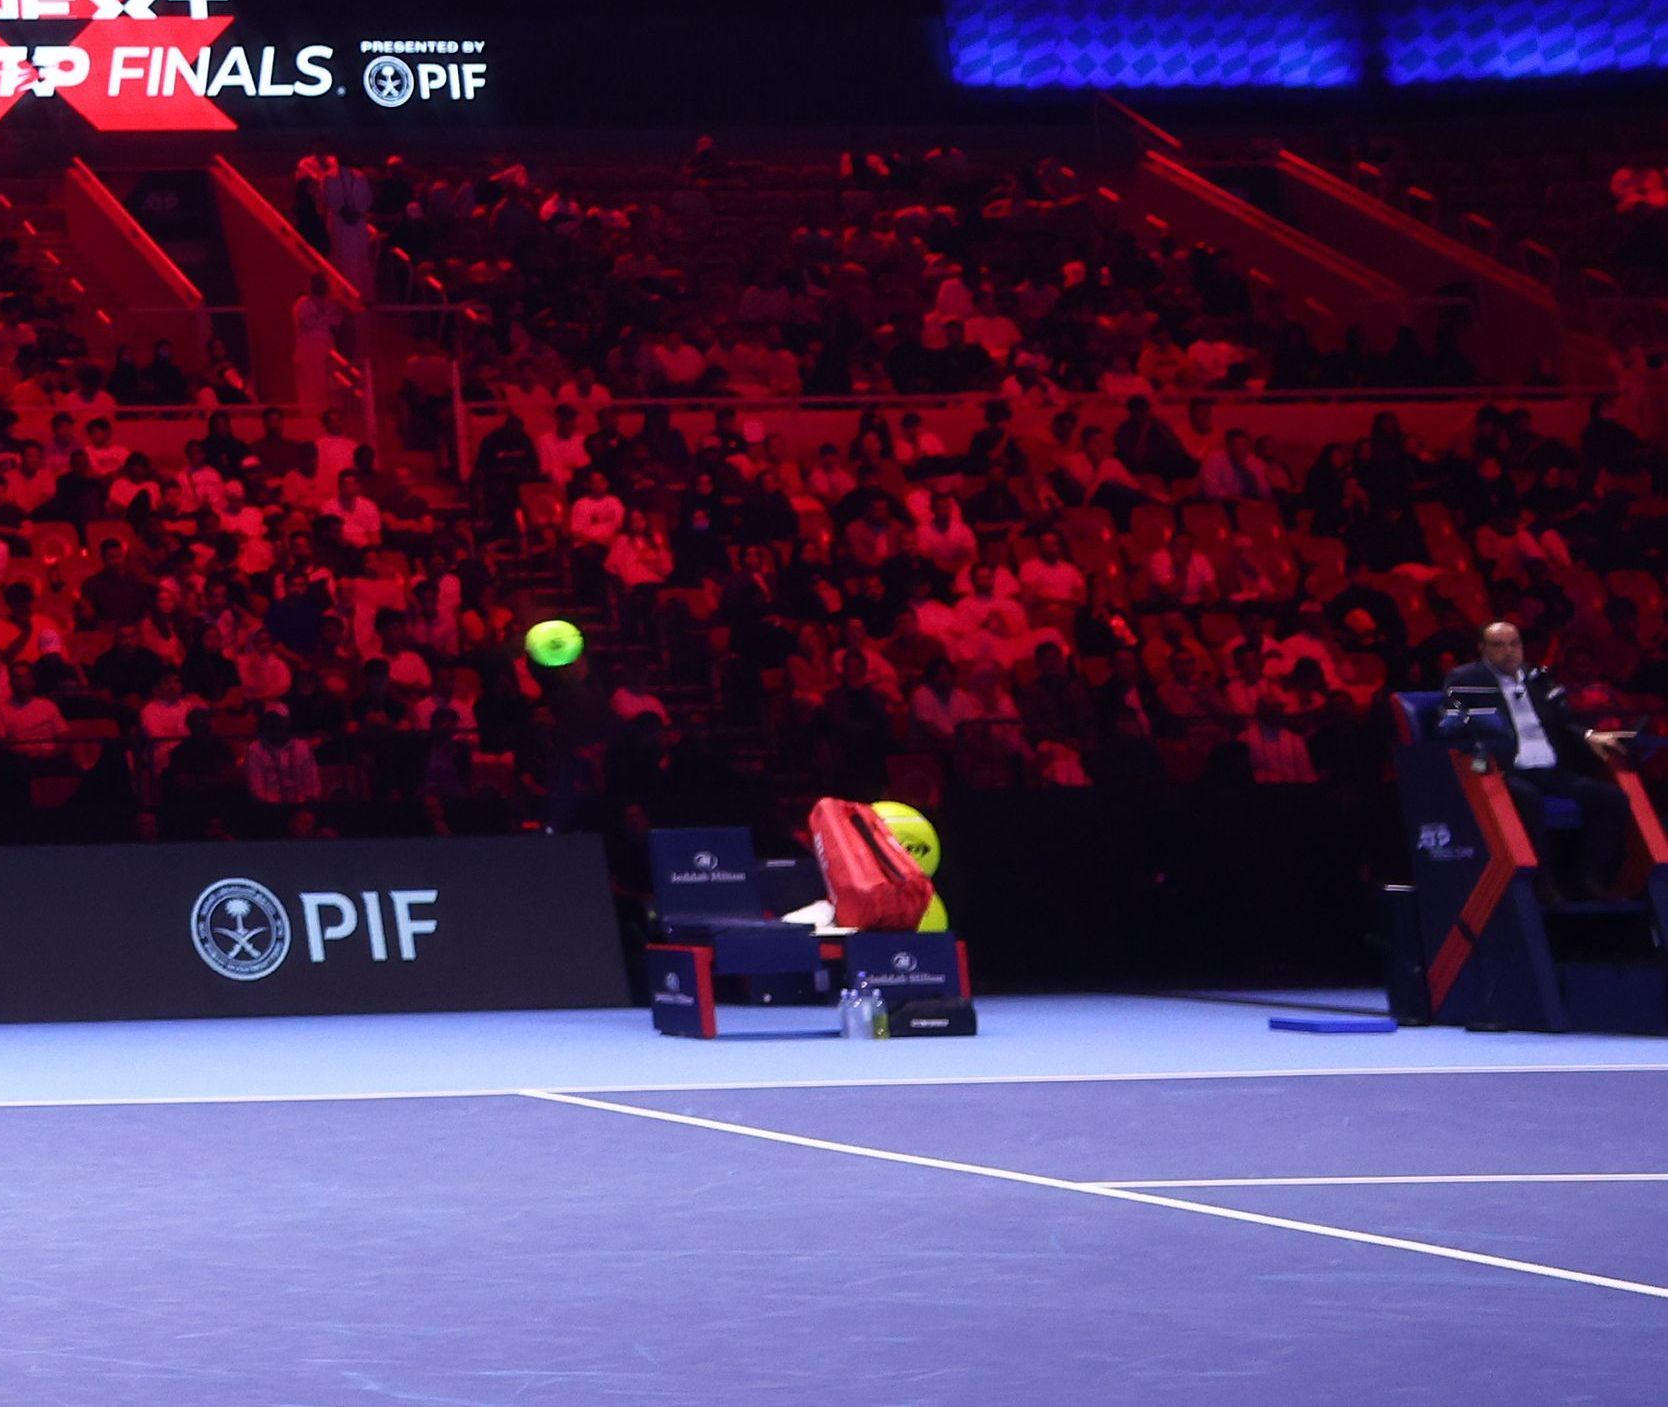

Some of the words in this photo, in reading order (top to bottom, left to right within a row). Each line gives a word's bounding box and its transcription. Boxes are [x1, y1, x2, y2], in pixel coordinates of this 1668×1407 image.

[360, 40, 459, 53] PRESENTED
[461, 40, 485, 53] BY
[107, 45, 334, 98] FINALS
[417, 63, 487, 100] PIF
[299, 889, 439, 964] PIF
